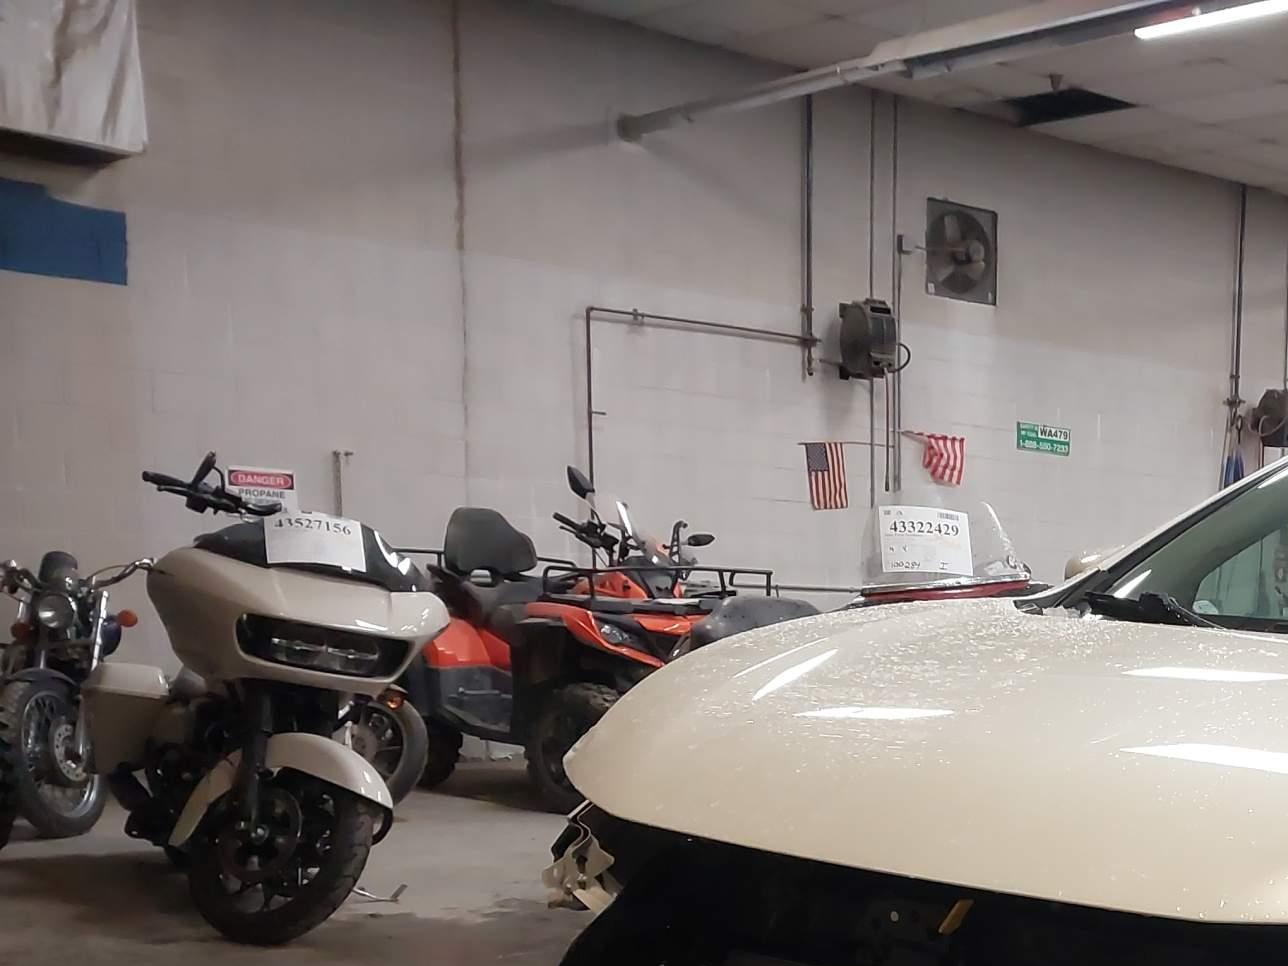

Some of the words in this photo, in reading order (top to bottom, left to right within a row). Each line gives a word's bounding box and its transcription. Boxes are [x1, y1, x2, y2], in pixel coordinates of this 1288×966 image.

[1040, 427, 1068, 440] WA479
[237, 474, 284, 486] DANGER
[238, 488, 285, 499] PROPANE
[274, 517, 352, 536] 43527156
[889, 520, 959, 536] 43322429
